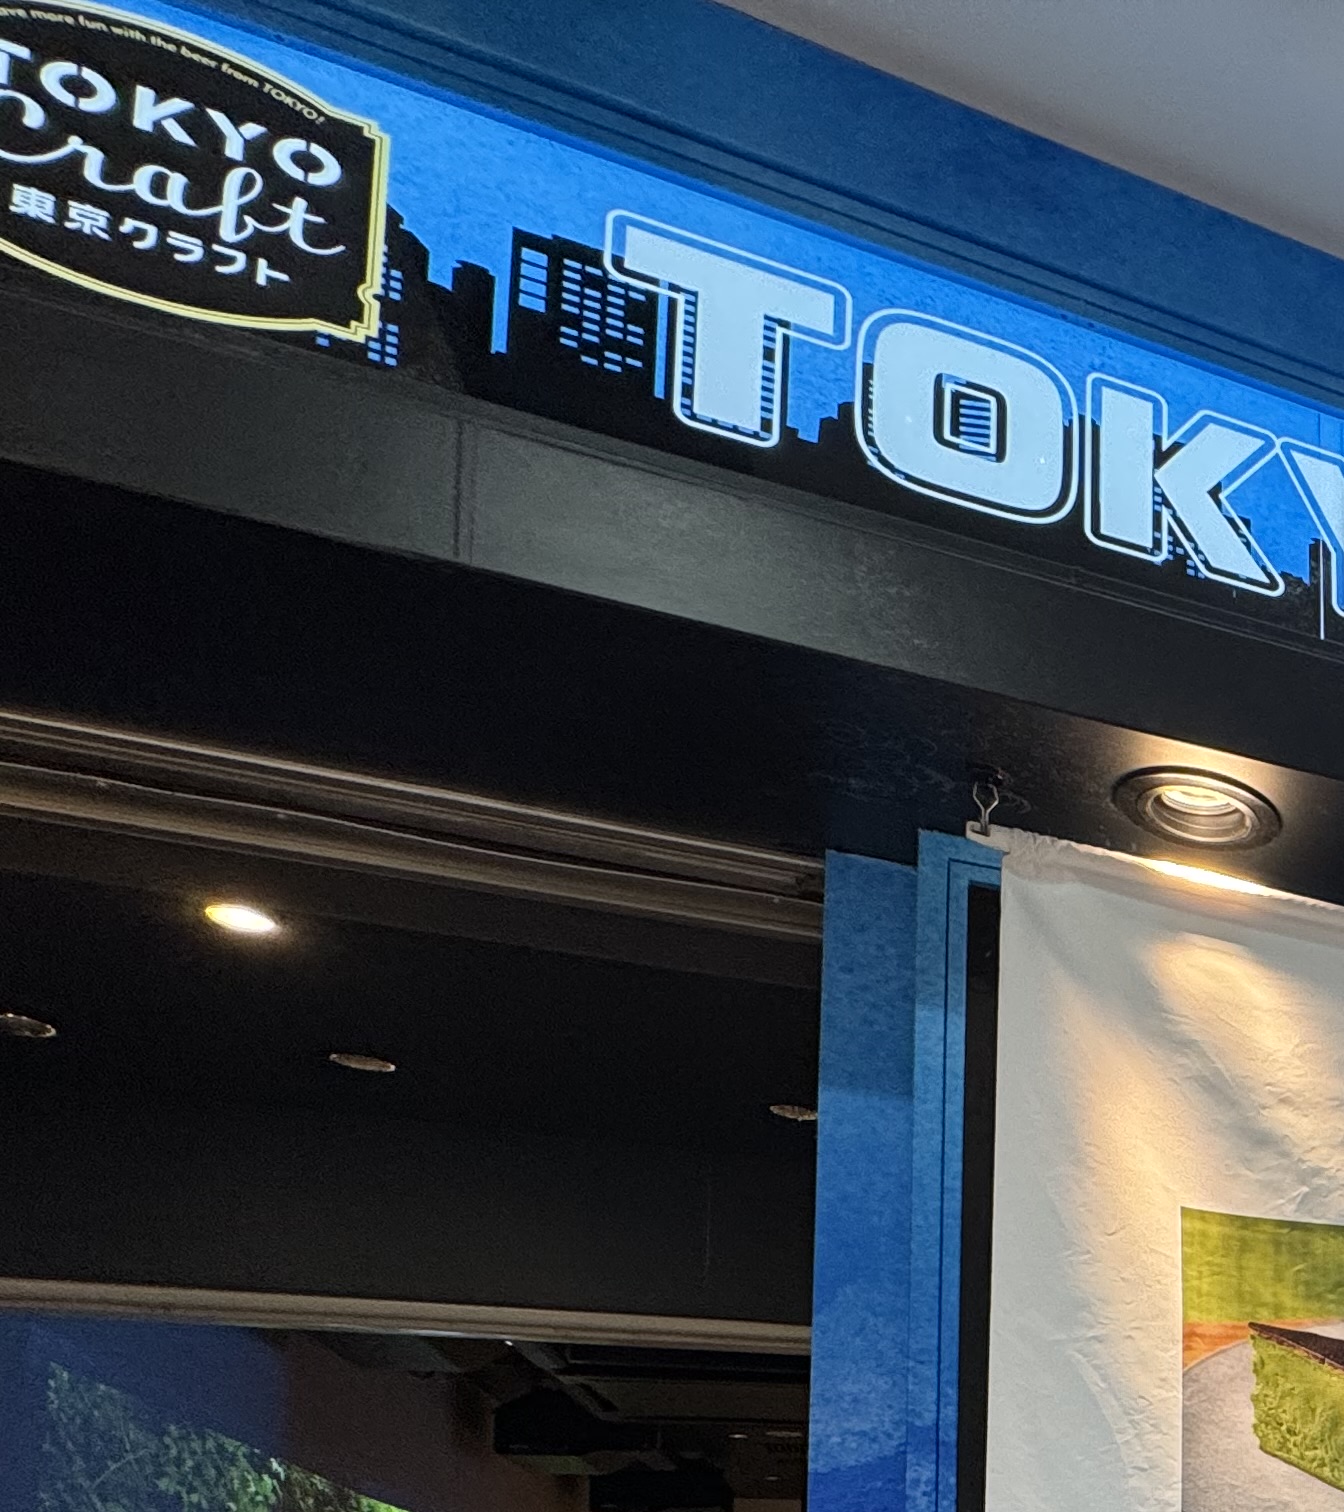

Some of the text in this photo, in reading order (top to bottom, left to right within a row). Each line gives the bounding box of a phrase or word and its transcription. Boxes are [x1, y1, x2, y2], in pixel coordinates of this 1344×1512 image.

[30, 9, 326, 125] more fun with the beer from TOKYO!
[9, 184, 291, 286] 東京クラフト
